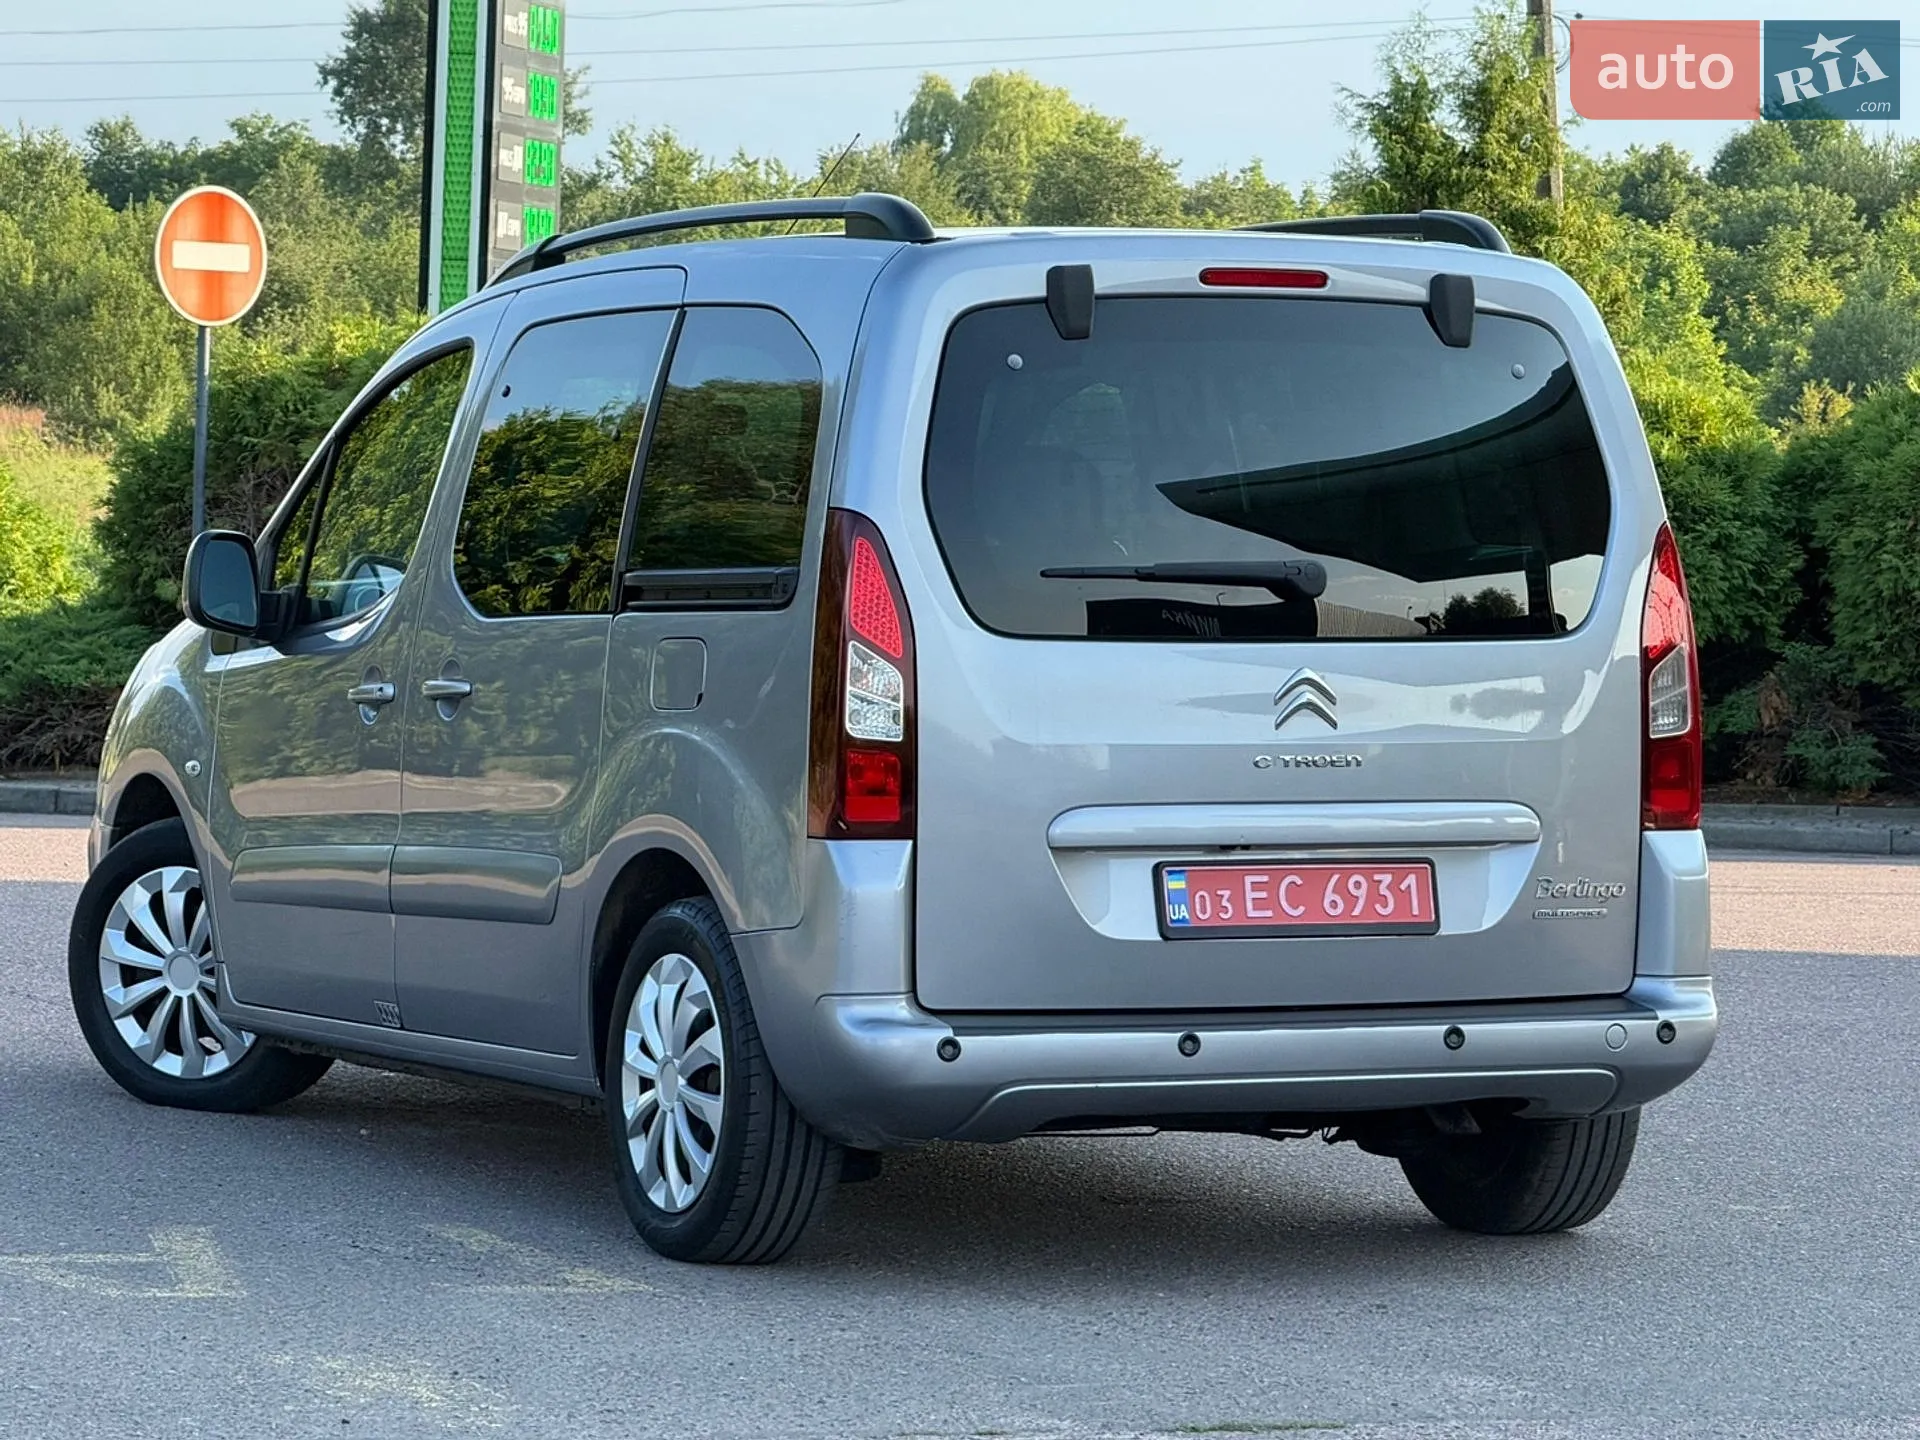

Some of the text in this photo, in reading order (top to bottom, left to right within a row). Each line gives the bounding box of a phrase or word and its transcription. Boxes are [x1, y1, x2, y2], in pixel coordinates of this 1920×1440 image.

[1194, 872, 1420, 920] 03 EC 6931
[1535, 876, 1626, 904] Berlingo
[1169, 903, 1189, 920] UA
